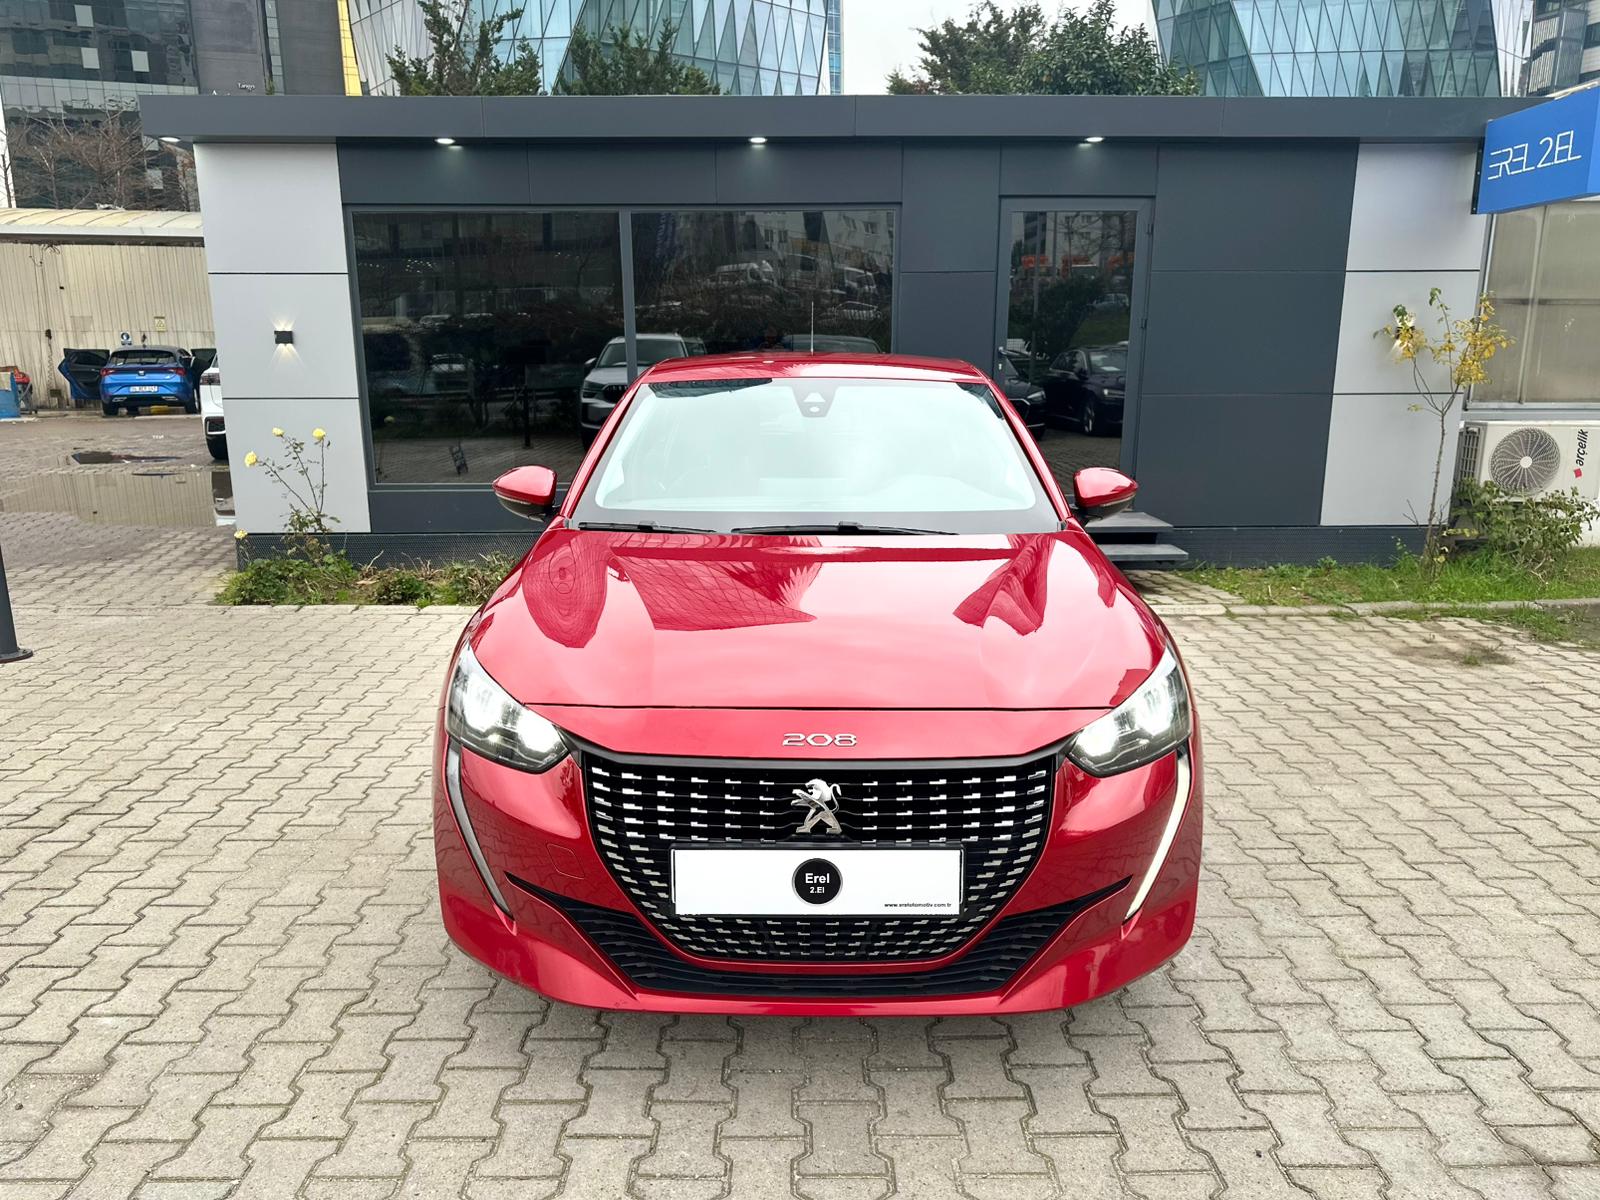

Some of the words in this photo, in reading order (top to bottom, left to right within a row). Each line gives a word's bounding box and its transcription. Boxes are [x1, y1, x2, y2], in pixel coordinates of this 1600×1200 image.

[1488, 144, 1535, 180] EREL
[1576, 429, 1589, 467] arçelik
[782, 733, 857, 747] 208
